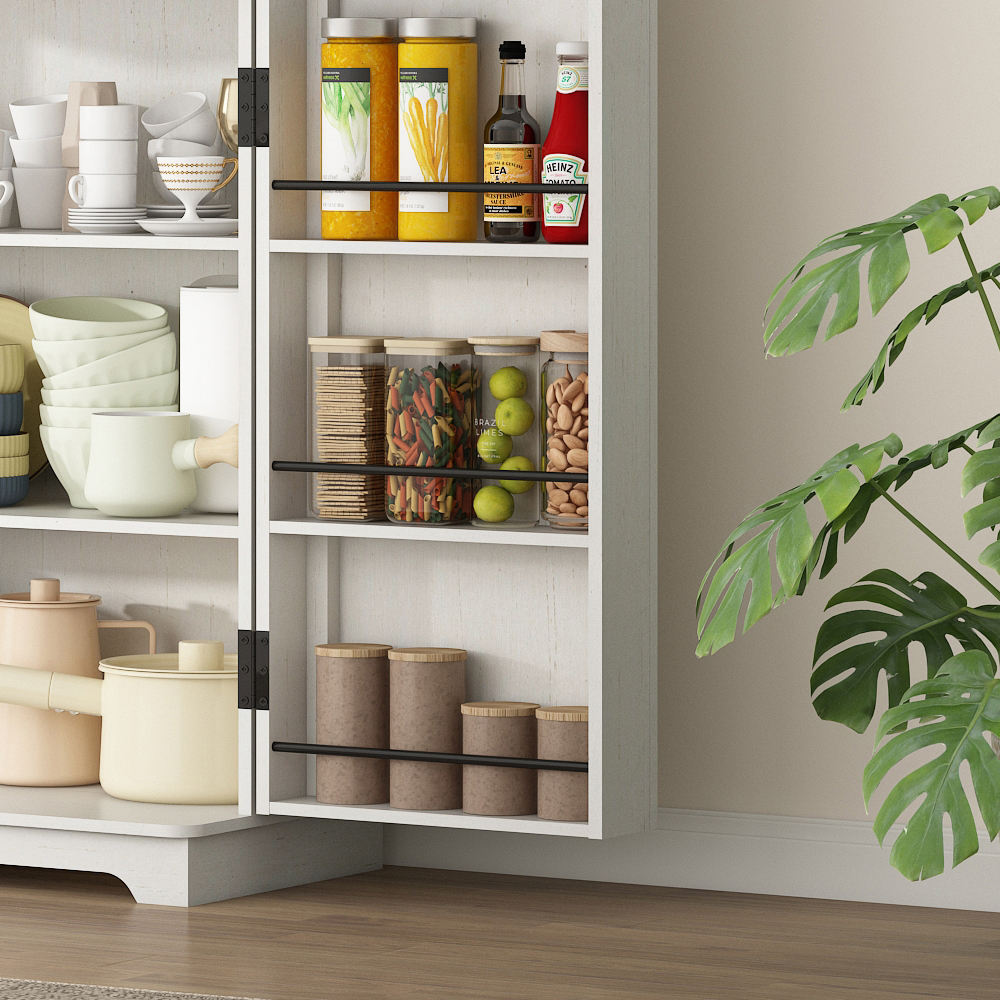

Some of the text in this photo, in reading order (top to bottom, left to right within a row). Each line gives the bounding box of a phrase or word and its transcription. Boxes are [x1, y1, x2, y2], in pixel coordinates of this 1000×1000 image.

[489, 166, 507, 175] LEA
[546, 162, 574, 173] HEINZ
[474, 418, 507, 427] BRAZIL
[476, 429, 505, 437] LIMES
